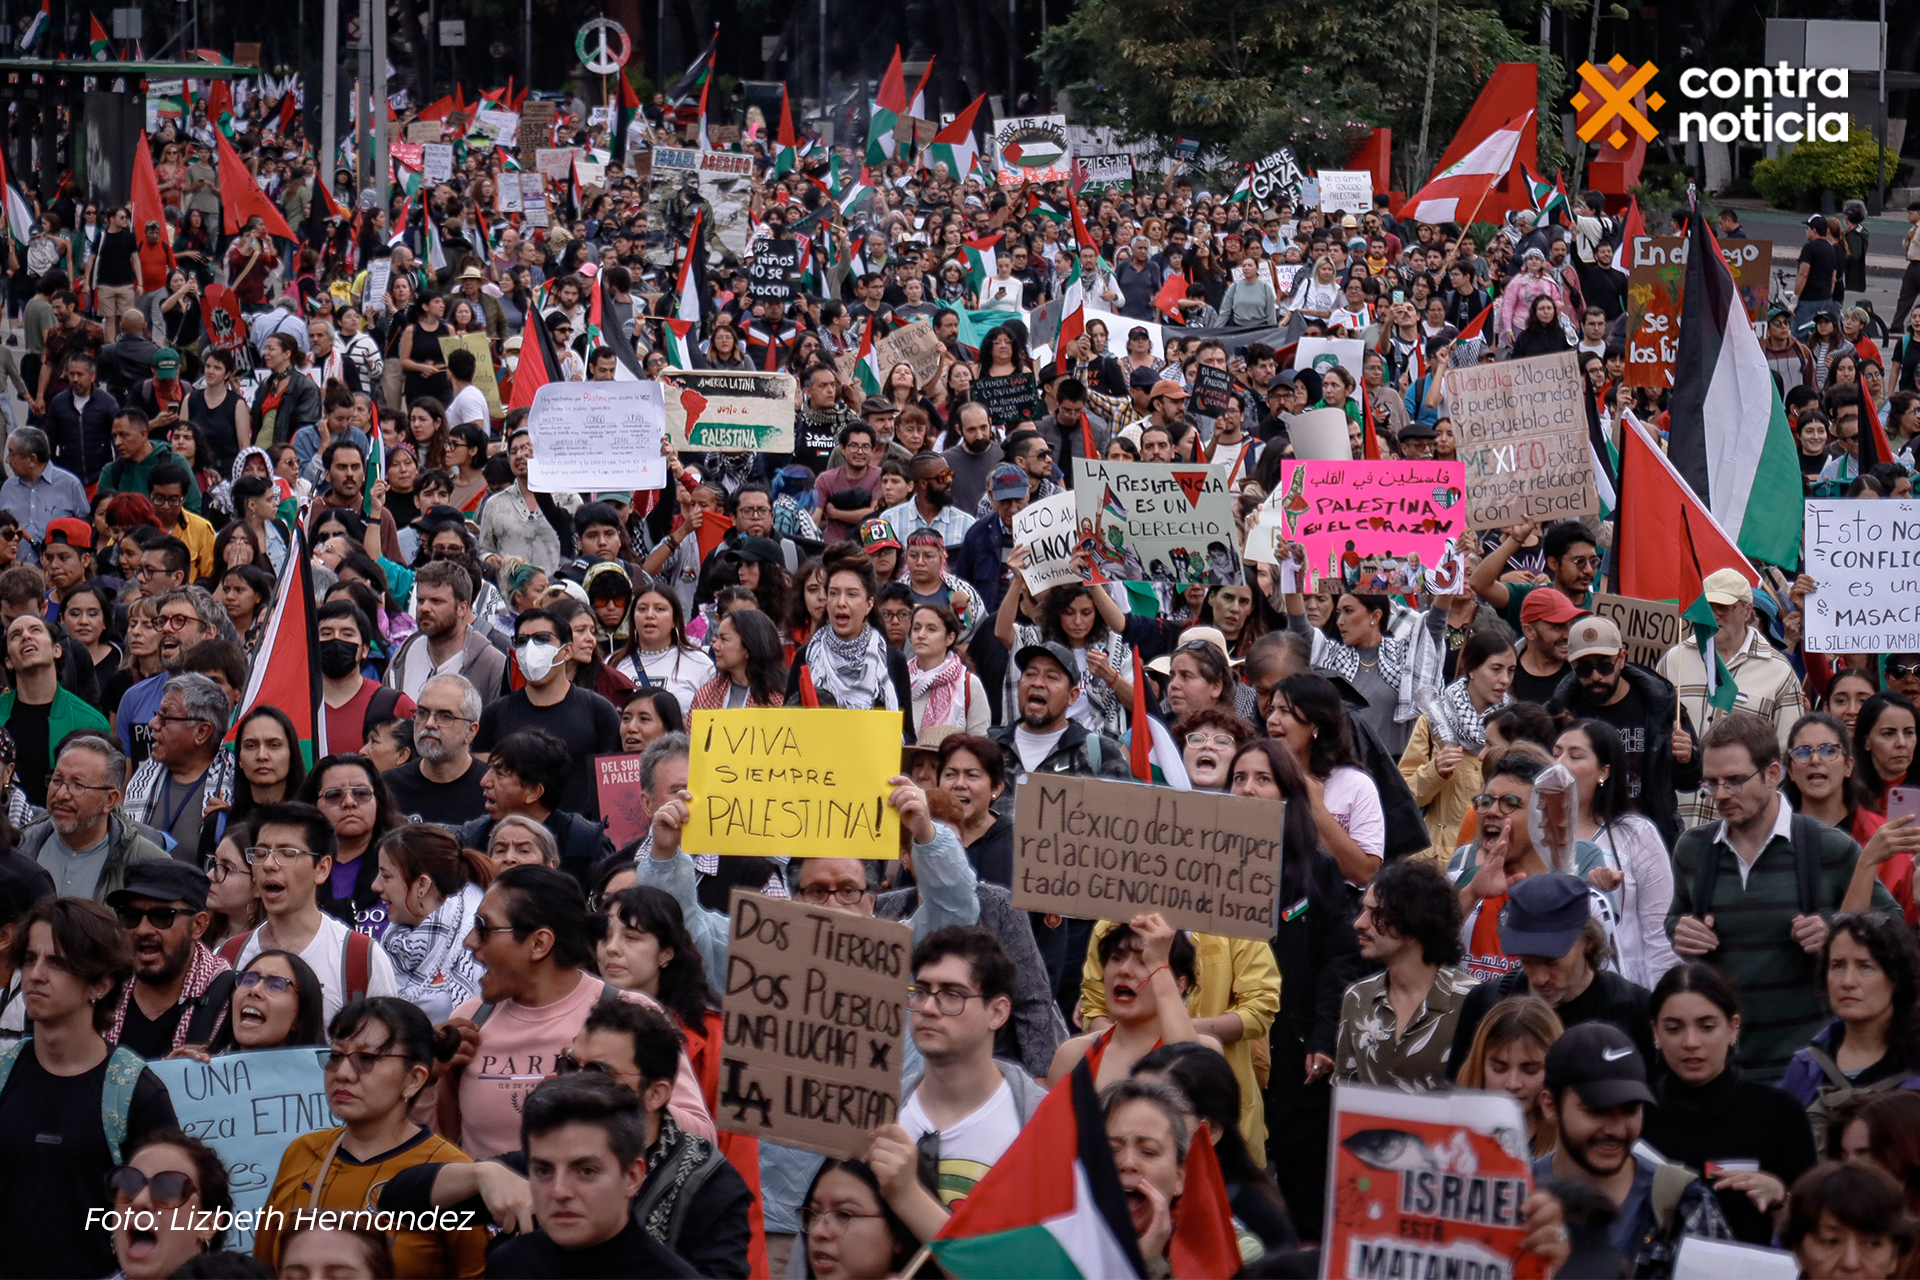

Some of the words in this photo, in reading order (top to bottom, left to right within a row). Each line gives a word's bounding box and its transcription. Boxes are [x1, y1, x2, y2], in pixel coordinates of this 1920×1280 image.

[654, 149, 697, 169] ISRAEL
[700, 154, 752, 174] ASESINO
[1174, 149, 1196, 160] LIBRE
[1254, 148, 1294, 174] LIBRE
[998, 165, 1024, 185] Free
[1077, 155, 1130, 178] PALESTINA
[1080, 178, 1126, 194] LIBRE
[1251, 162, 1305, 199] GAZA
[1329, 191, 1362, 201] PALESTINA
[757, 253, 795, 267] niños
[1633, 237, 1666, 268] En
[1669, 238, 1690, 264] el
[767, 268, 784, 280] se
[749, 281, 790, 298] tocan
[1641, 312, 1669, 334] se
[1629, 341, 1658, 364] los
[729, 378, 756, 392] LATINA
[976, 379, 1009, 390] DEFENDER
[1549, 365, 1574, 385] que
[1451, 399, 1464, 416] el
[1468, 391, 1518, 417] pueblo
[1519, 380, 1580, 406] manda?
[586, 414, 605, 424] CONGO
[1454, 418, 1467, 438] Y
[1470, 417, 1486, 438] el
[1491, 411, 1549, 441] pueblo
[1553, 407, 1574, 424] de
[699, 428, 759, 449] PALESTINA
[1558, 433, 1575, 451] TE
[1460, 441, 1547, 477] MÉXICO
[1549, 448, 1590, 468] EXIGE
[1085, 461, 1110, 481] LA
[1310, 469, 1346, 487] القلب
[1352, 470, 1374, 491] في
[1378, 467, 1451, 487] فلسطين
[1465, 479, 1526, 500] romper
[1530, 468, 1596, 491] relación
[1060, 507, 1075, 524] AL
[1135, 498, 1156, 514] ES
[1163, 498, 1187, 515] UN
[1316, 497, 1438, 517] PALESTINA
[1473, 504, 1510, 524] con
[1519, 487, 1588, 517] Israel
[1128, 520, 1220, 537] DERECHO
[1303, 522, 1323, 537] EN
[1326, 521, 1351, 533] EL
[1816, 509, 1883, 545] Esto
[1848, 581, 1874, 597] es
[1627, 608, 1694, 645] INSOP
[1807, 636, 1821, 651] EL
[1824, 634, 1880, 651] SILENCIO
[601, 761, 620, 774] DEL
[620, 758, 640, 772] SUR
[714, 765, 837, 787] SIEMPRE
[602, 773, 610, 785] A
[610, 770, 641, 784] PALES
[706, 795, 884, 842] PALESTINA!
[1038, 785, 1140, 845] México
[1144, 797, 1194, 849] debe
[1201, 829, 1281, 865] romper
[1020, 833, 1168, 877] relaciones
[1175, 856, 1222, 888] con
[1226, 861, 1243, 894] el
[1022, 867, 1081, 897] tado
[1088, 873, 1193, 911] GENOCIDA
[1195, 895, 1214, 914] de
[1218, 895, 1274, 928] Israel
[802, 967, 902, 1038] PUEBLOS
[723, 1010, 779, 1053] UNA
[784, 1019, 858, 1070] LUCHA
[183, 1059, 252, 1101] UNA
[720, 1057, 774, 1129] LA
[783, 1075, 899, 1130] LIBERTAD
[1400, 1169, 1529, 1228] ISRAEL
